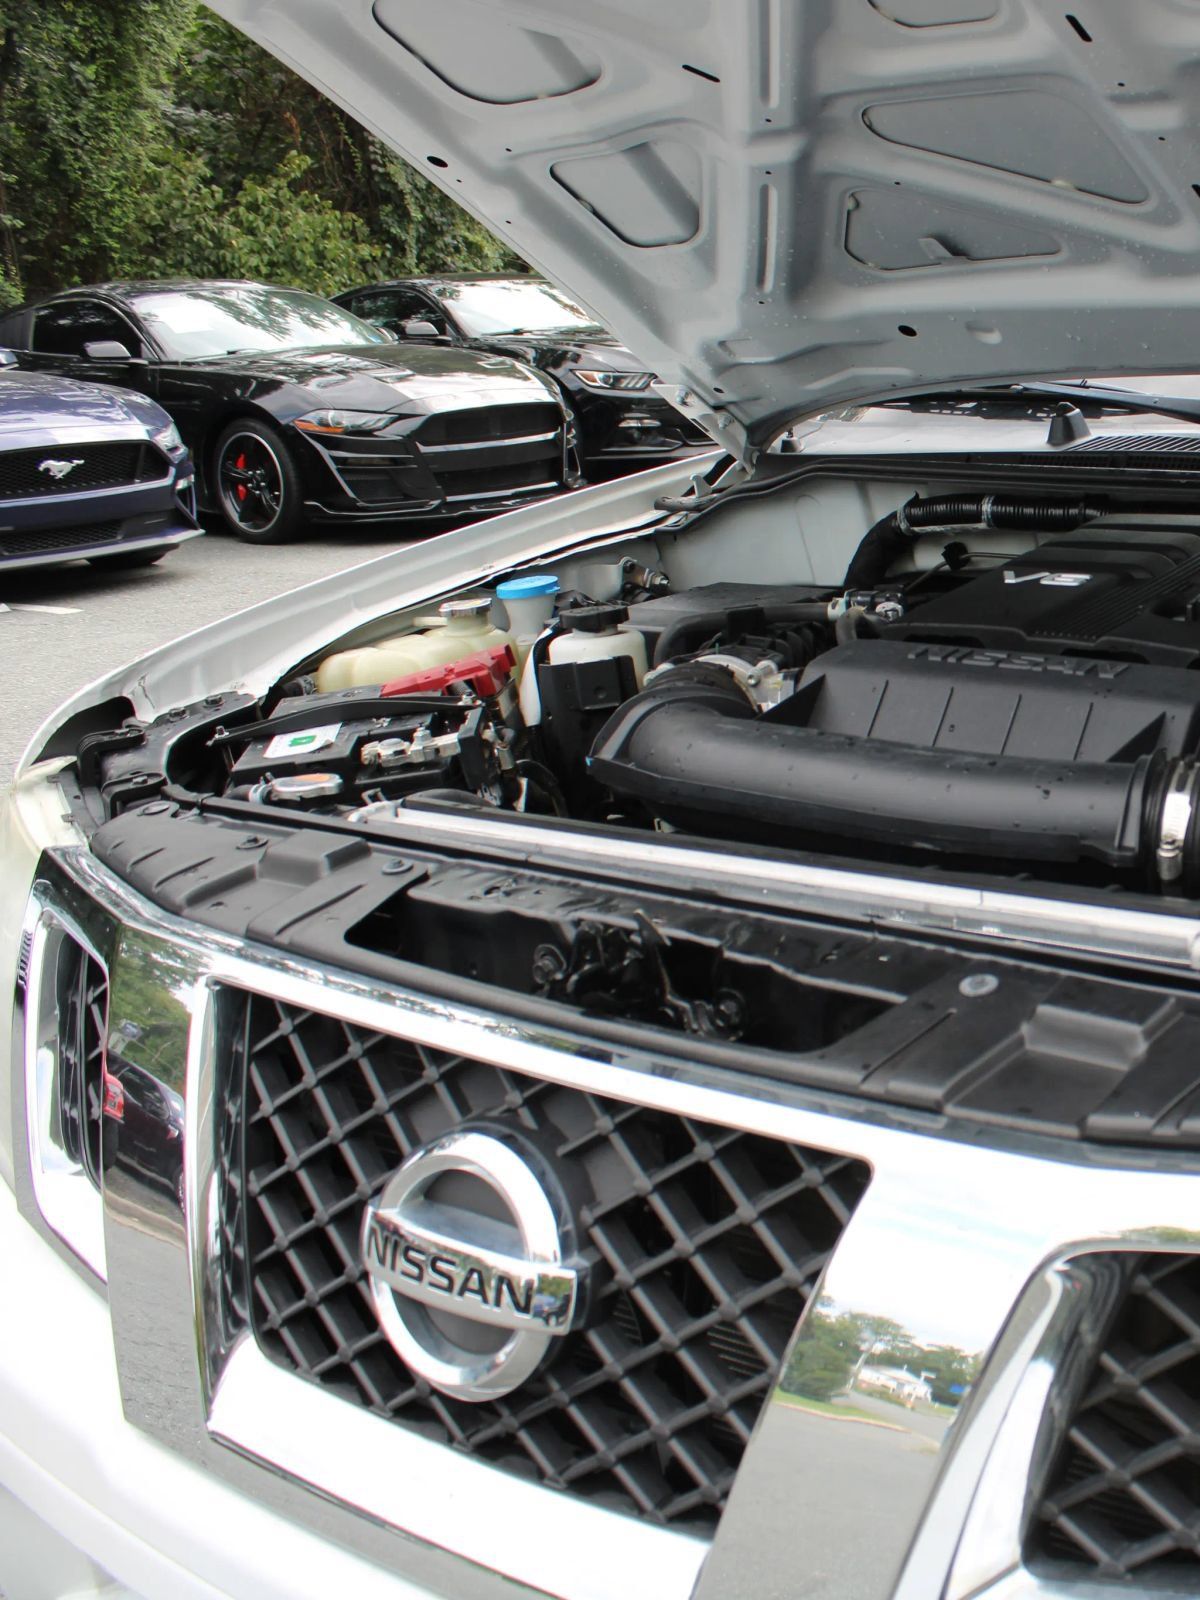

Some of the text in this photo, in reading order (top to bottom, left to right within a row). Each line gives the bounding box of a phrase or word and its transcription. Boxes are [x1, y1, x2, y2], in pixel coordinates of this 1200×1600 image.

[1003, 570, 1092, 587] V6
[907, 647, 1129, 679] NISSAN
[367, 1223, 535, 1317] NISSAN
